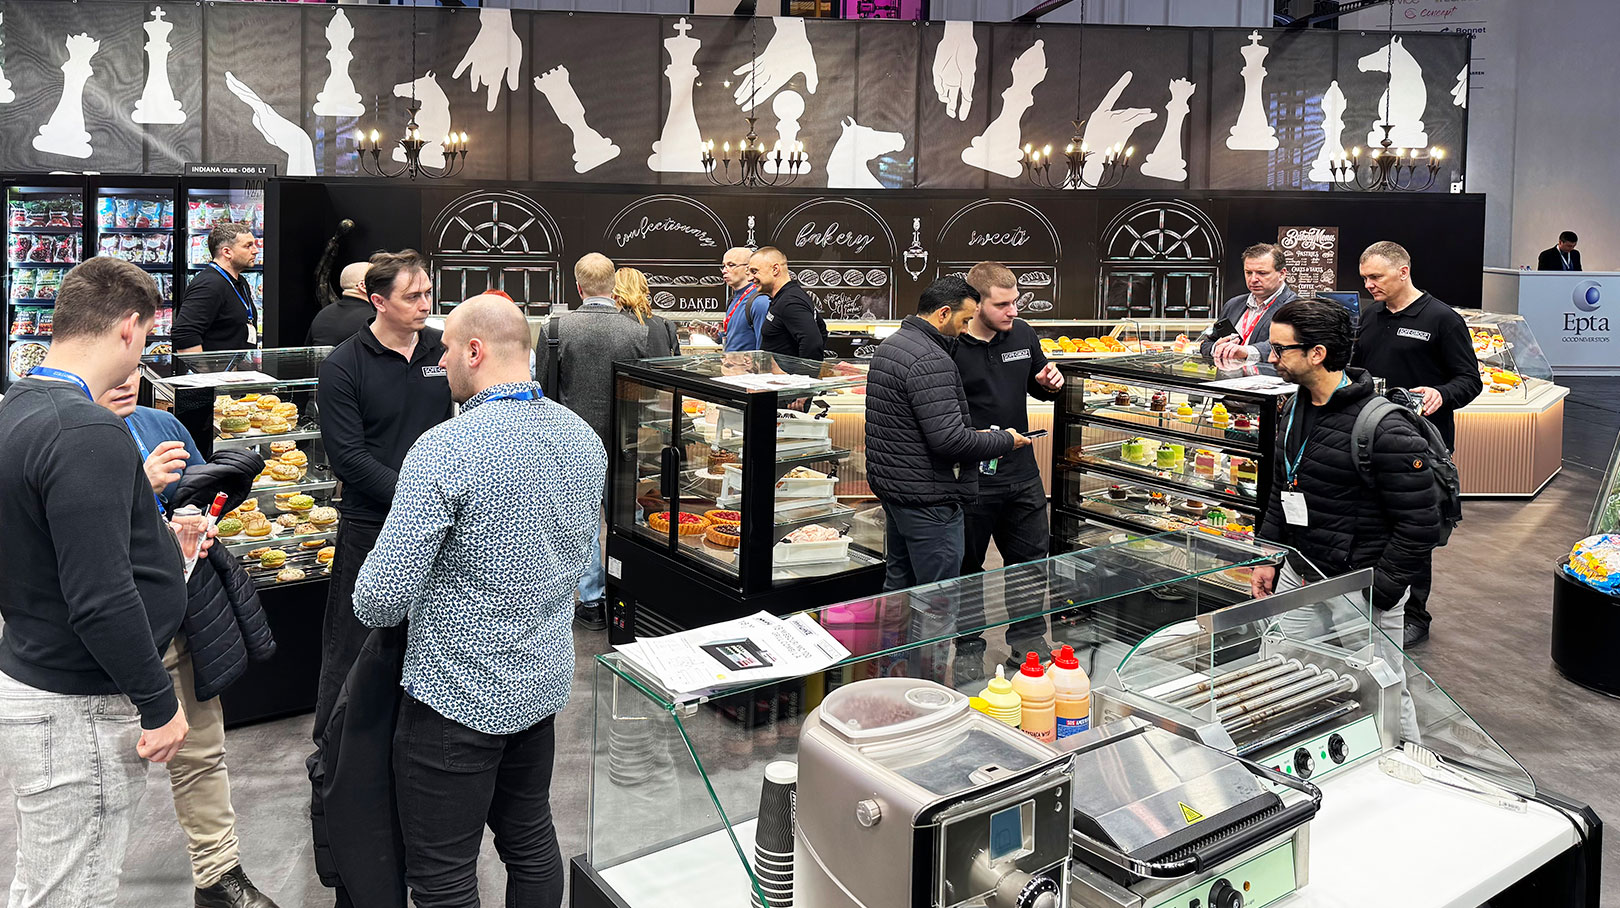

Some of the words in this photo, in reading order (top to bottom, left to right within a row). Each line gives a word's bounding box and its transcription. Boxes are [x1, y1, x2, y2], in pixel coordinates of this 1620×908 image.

[795, 221, 875, 254] bakery
[968, 226, 1030, 247] sweets
[680, 298, 719, 309] BAKED
[1563, 313, 1610, 335] Epta
